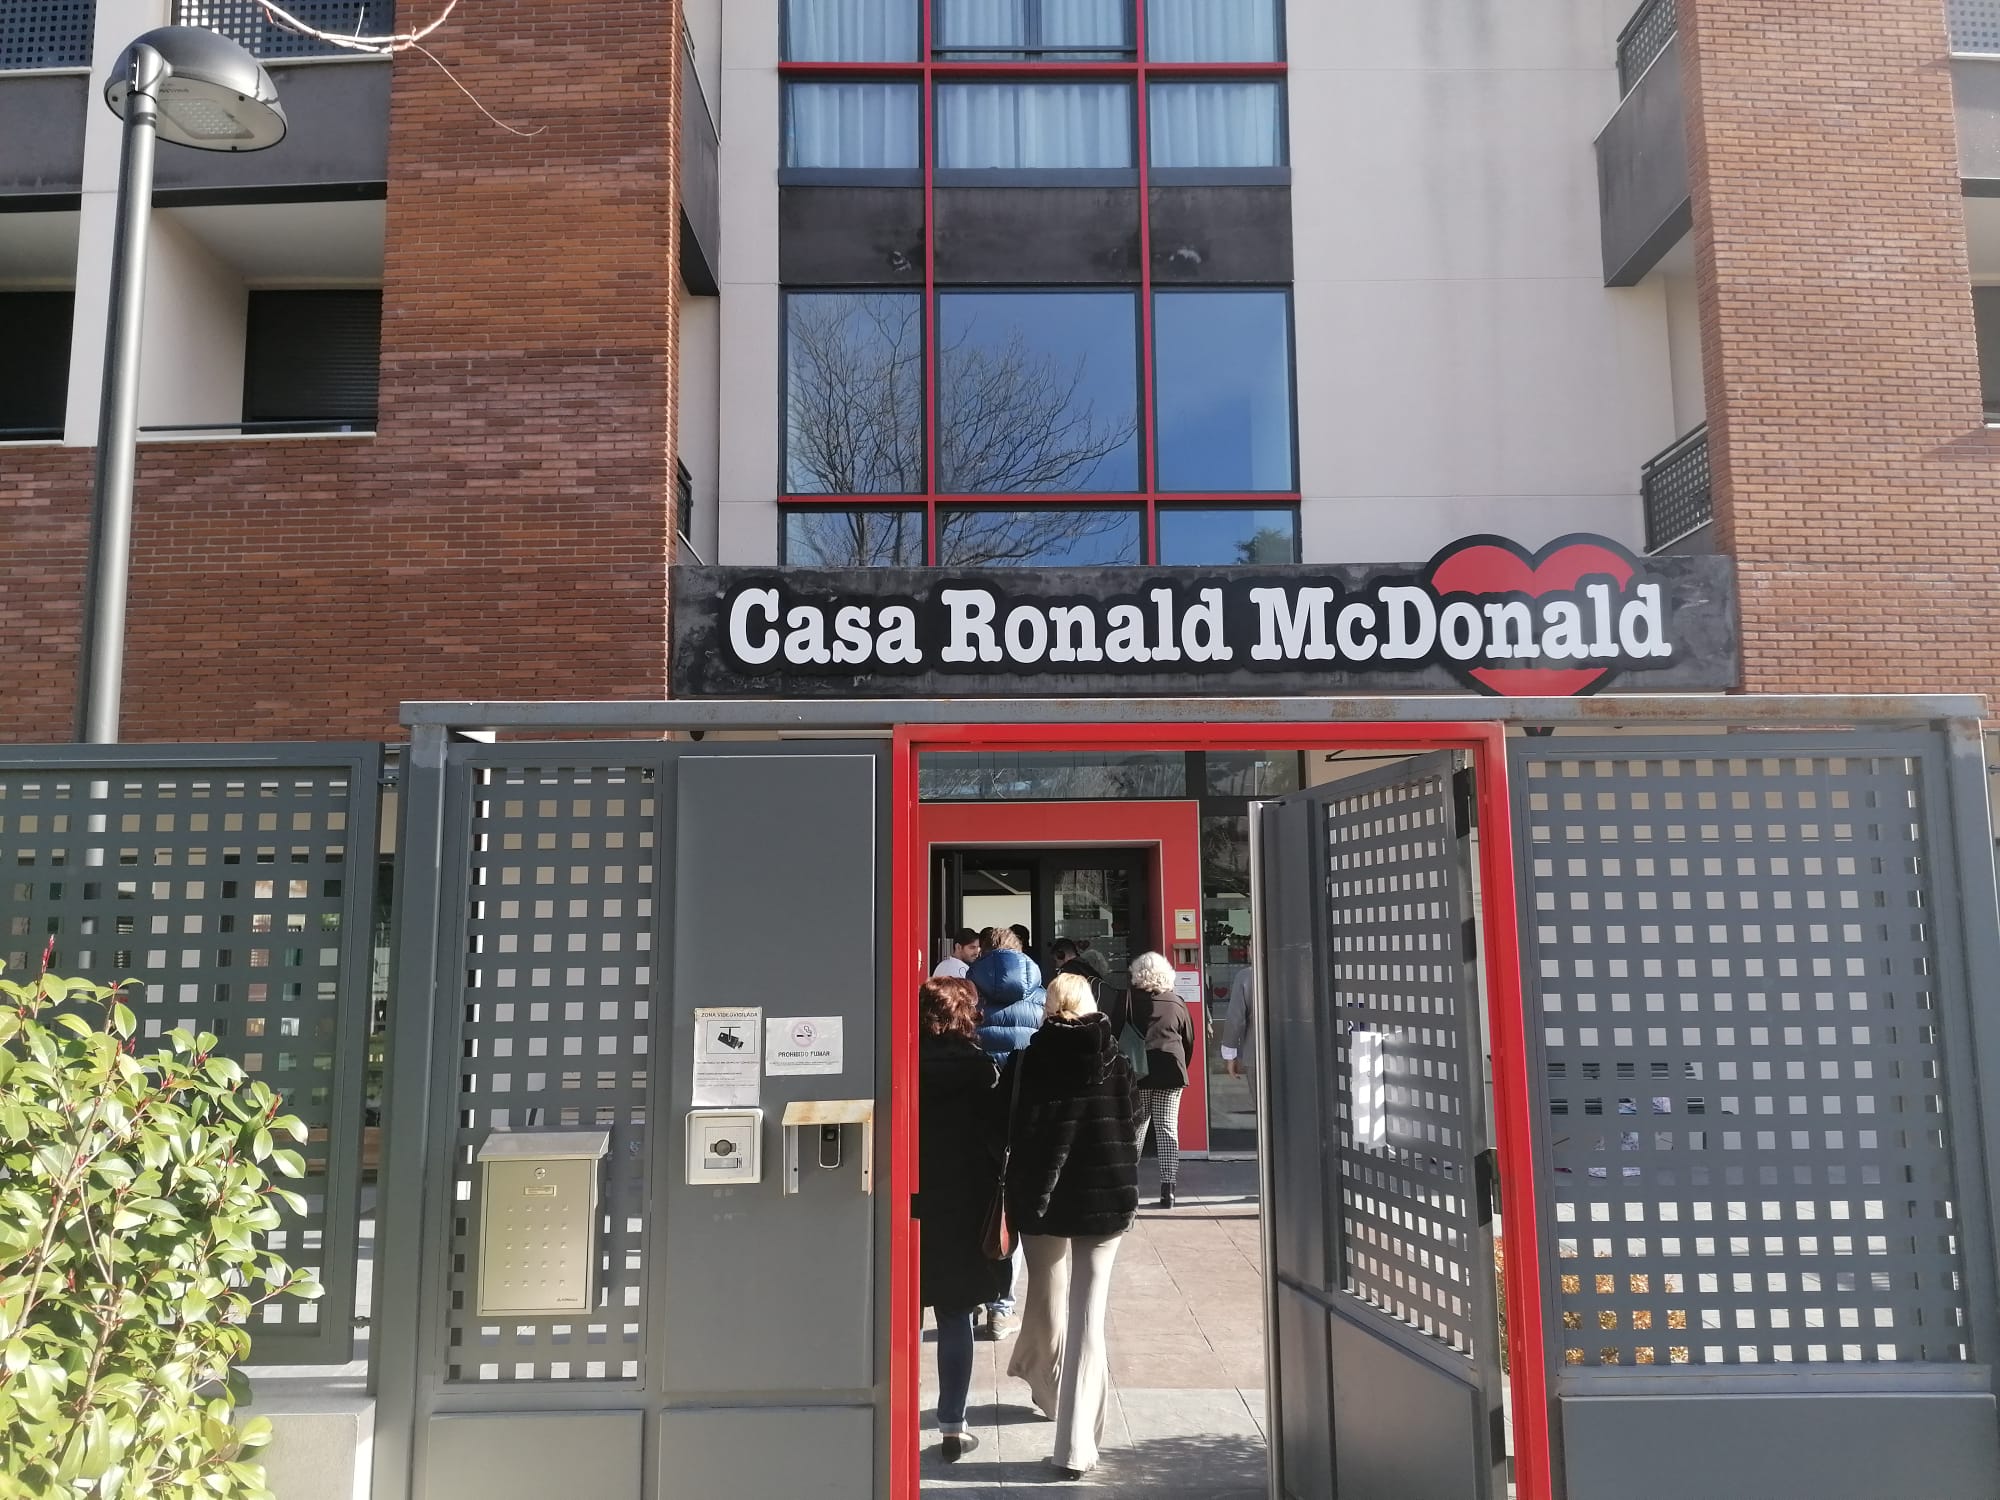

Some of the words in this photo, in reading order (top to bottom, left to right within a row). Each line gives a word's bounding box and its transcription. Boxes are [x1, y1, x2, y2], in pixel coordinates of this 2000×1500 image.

[729, 588, 923, 666] Casa
[940, 587, 1234, 665] Ronald
[1249, 582, 1673, 663] McDonald
